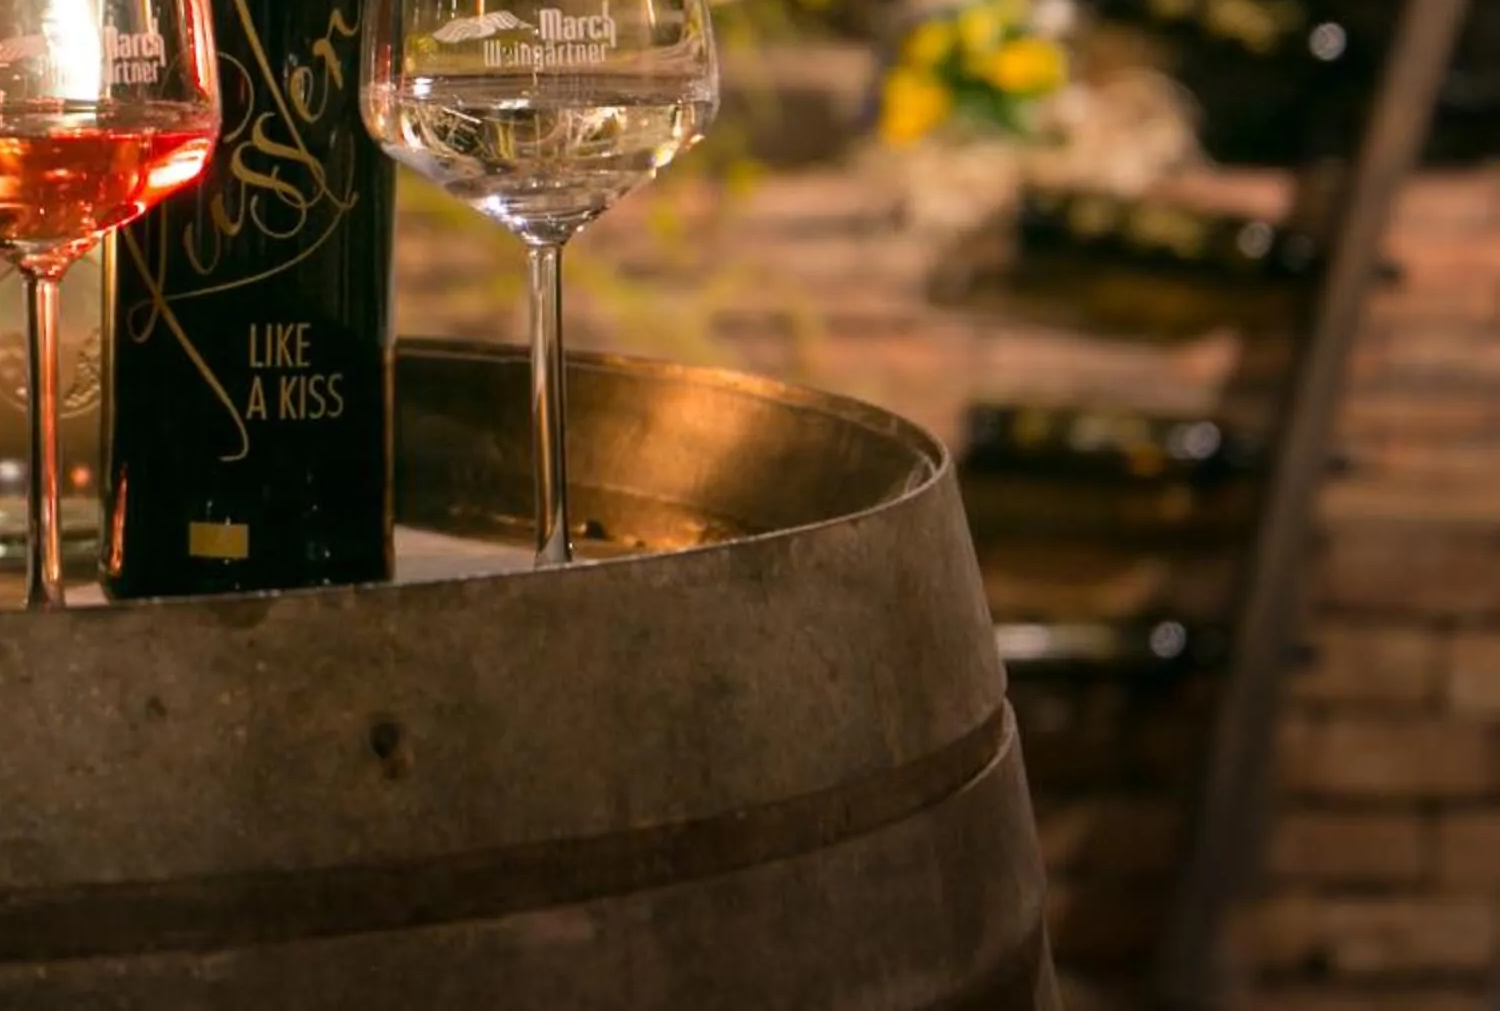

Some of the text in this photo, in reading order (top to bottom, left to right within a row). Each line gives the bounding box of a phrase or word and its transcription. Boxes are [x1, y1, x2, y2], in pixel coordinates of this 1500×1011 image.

[539, 0, 617, 48] March
[250, 323, 312, 368] LIKE
[246, 373, 344, 420] A KISS
